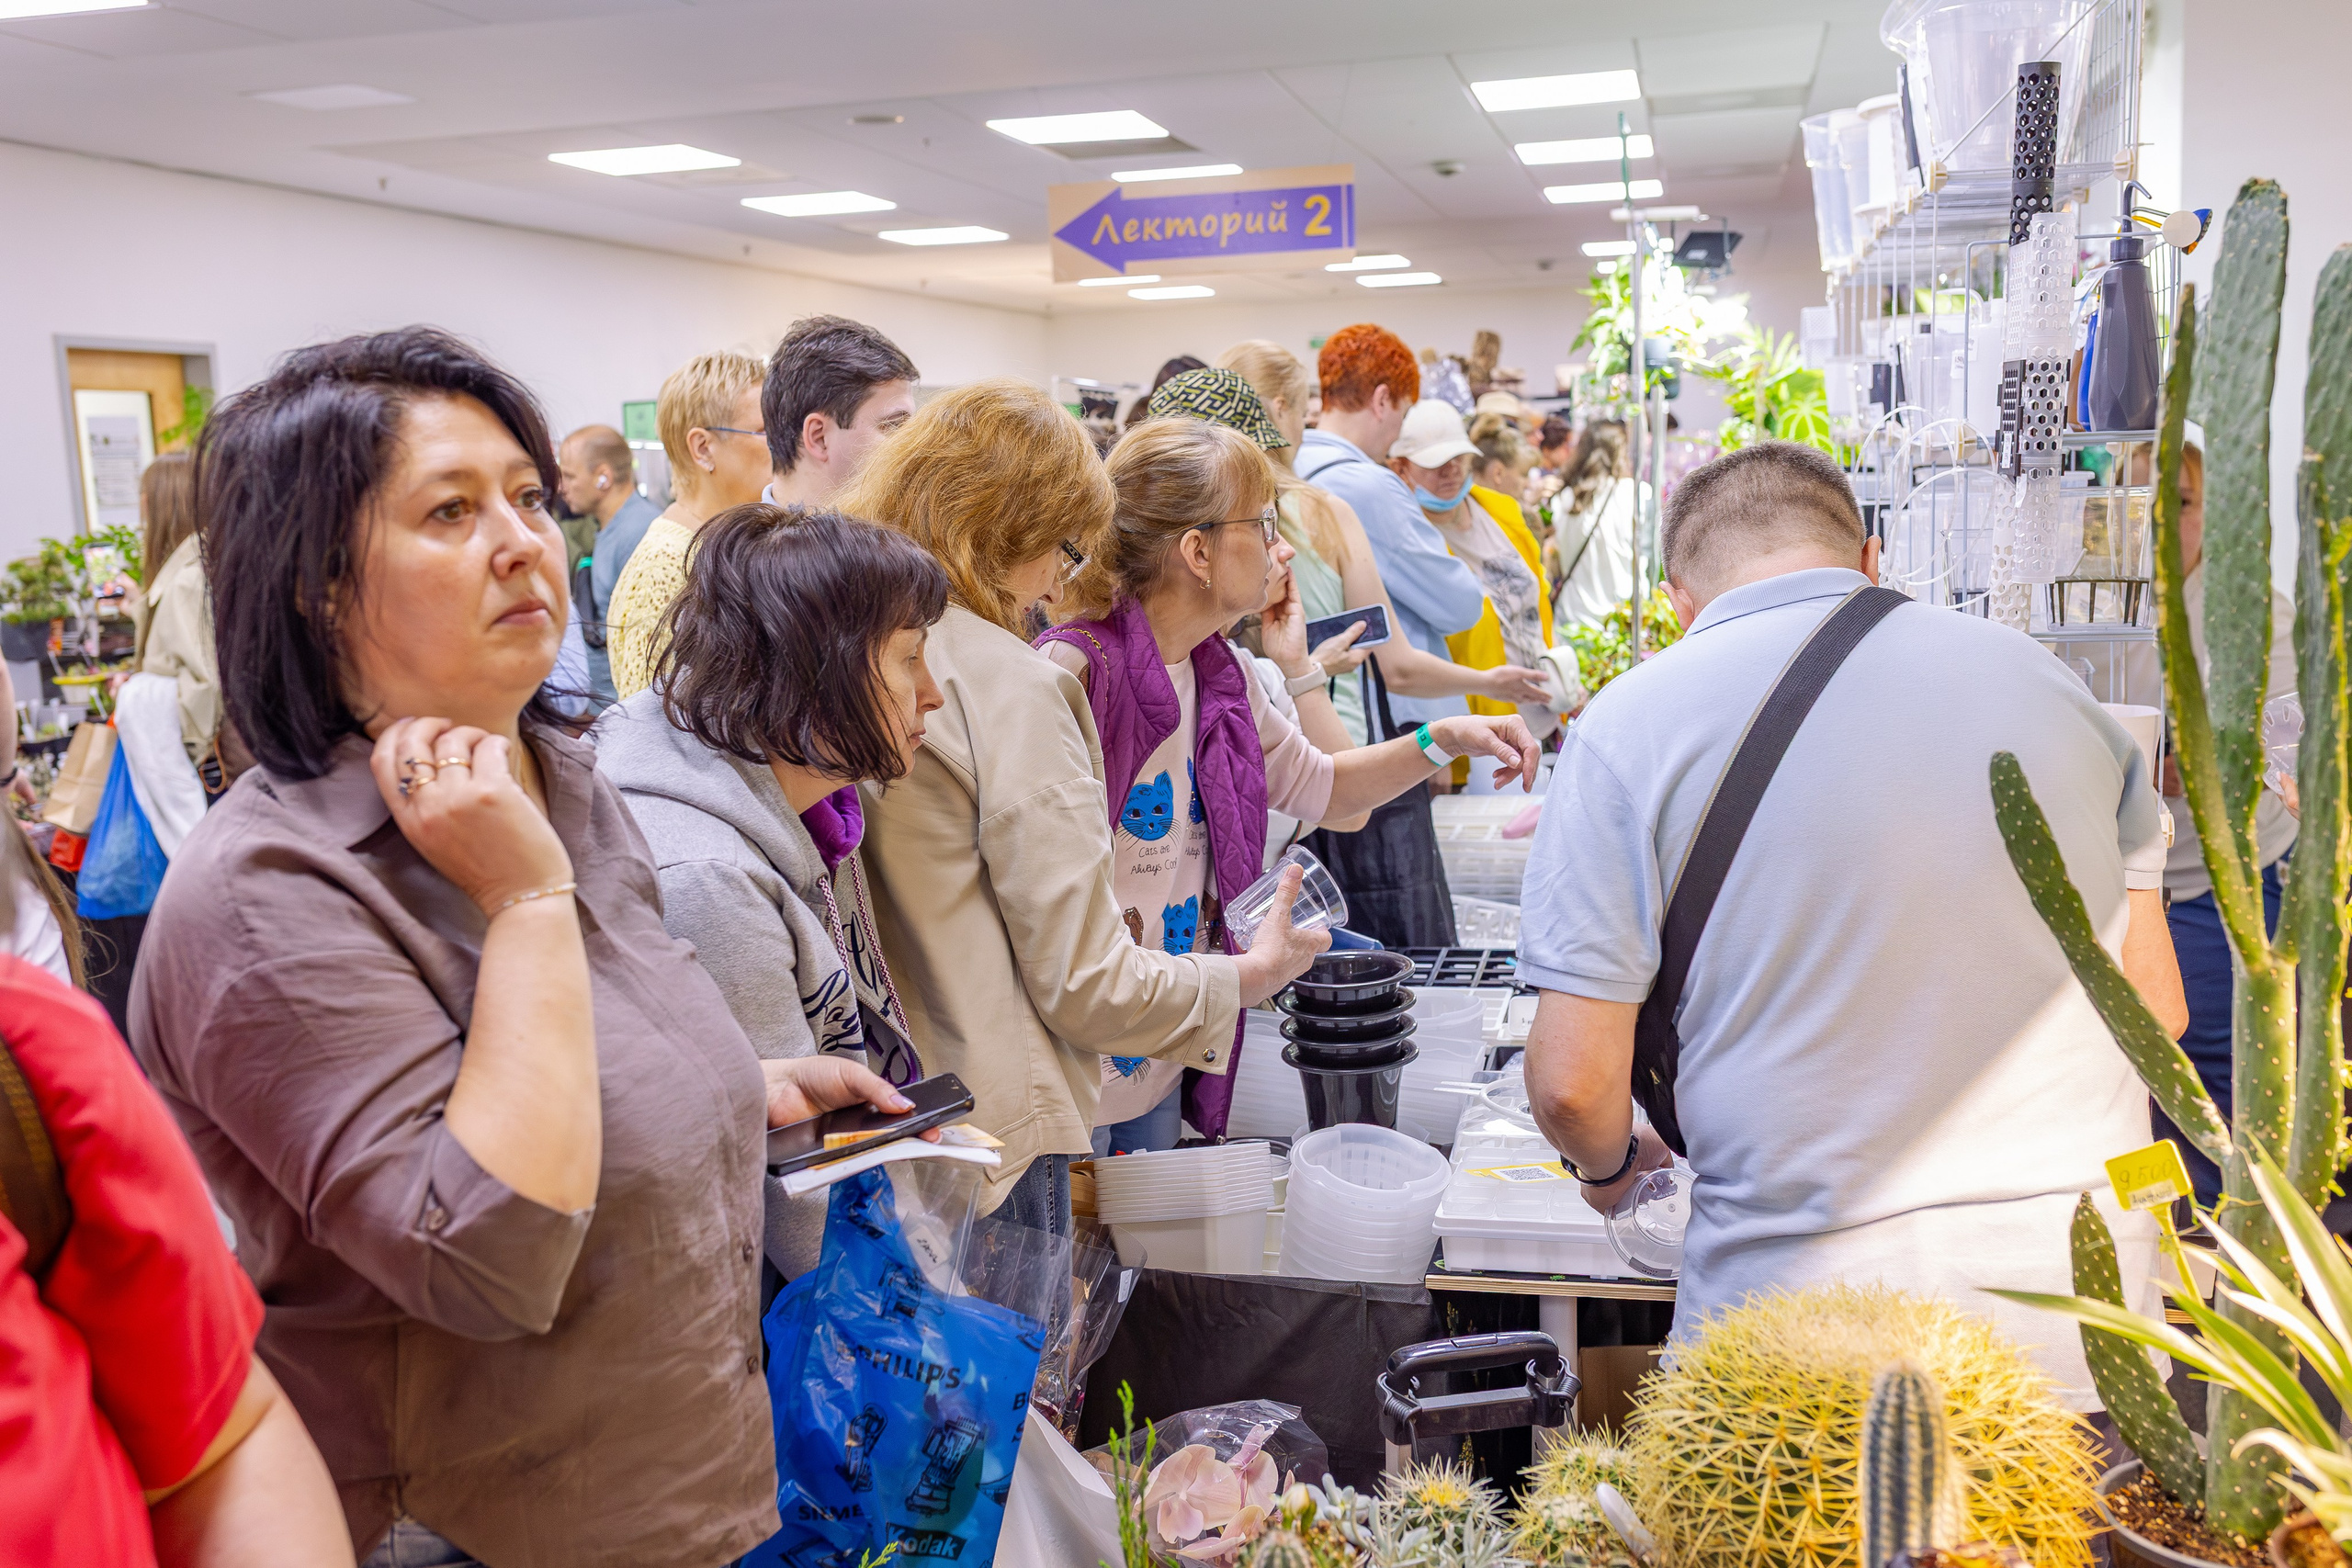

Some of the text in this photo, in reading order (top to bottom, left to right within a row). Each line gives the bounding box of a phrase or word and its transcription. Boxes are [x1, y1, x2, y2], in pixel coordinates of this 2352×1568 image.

[1091, 194, 1332, 248] Лекторий 2
[1130, 863, 1162, 876] Always
[1139, 846, 1158, 858] Cats
[855, 1344, 961, 1389] PHILIPS
[888, 1524, 958, 1559] Kodak
